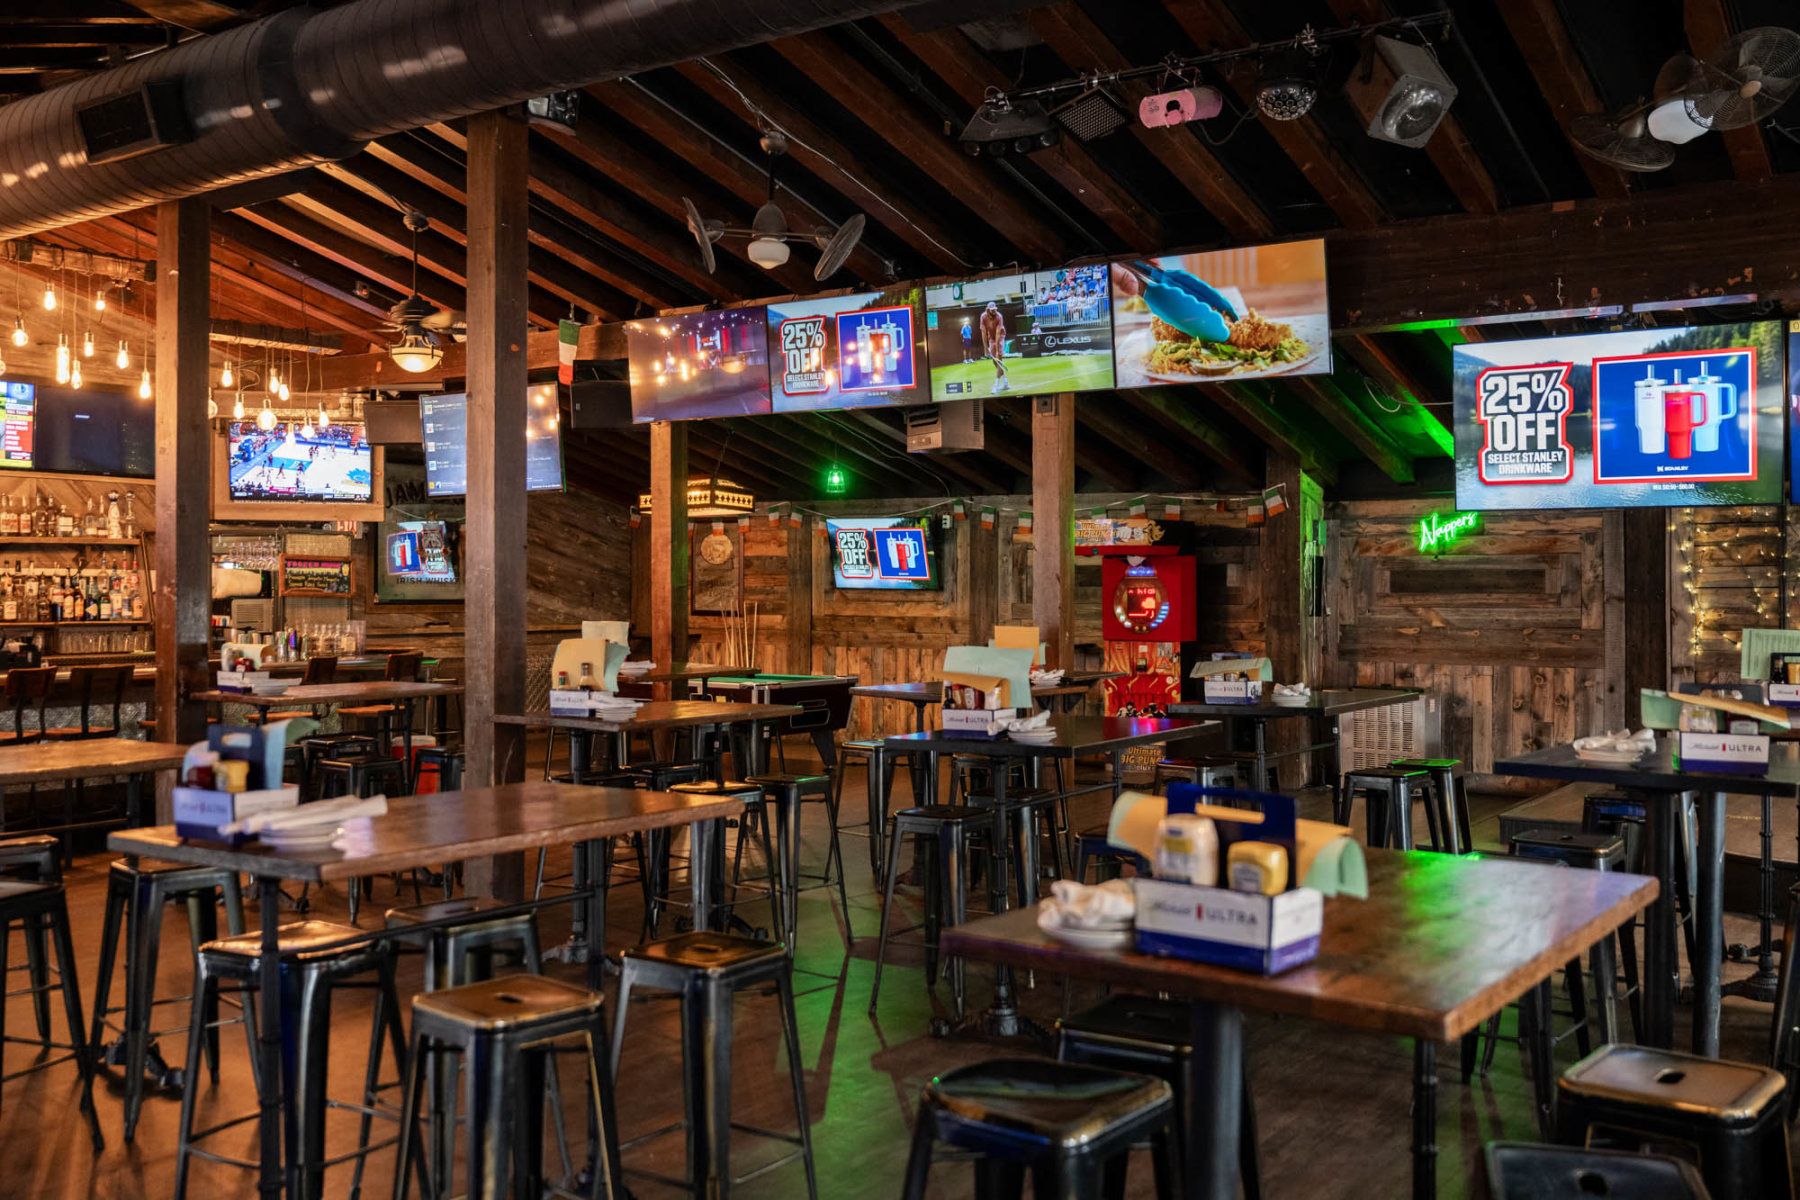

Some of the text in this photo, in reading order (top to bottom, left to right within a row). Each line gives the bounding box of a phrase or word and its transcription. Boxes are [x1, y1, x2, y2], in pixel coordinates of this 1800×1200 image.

[784, 322, 823, 349] 25%
[1057, 336, 1091, 344] LEXUS
[788, 348, 820, 373] OFF
[1485, 372, 1563, 413] 25%
[1493, 413, 1556, 451] OFF
[1488, 451, 1563, 464] SELECT STANLEY
[1499, 463, 1553, 475] DRINKWARE
[1420, 512, 1477, 552] Nappers
[840, 533, 866, 549] 25%
[843, 549, 865, 564] OFF
[396, 577, 423, 585] IRISH
[1728, 744, 1762, 753] ULTRA
[1206, 909, 1258, 925] ULTRA
